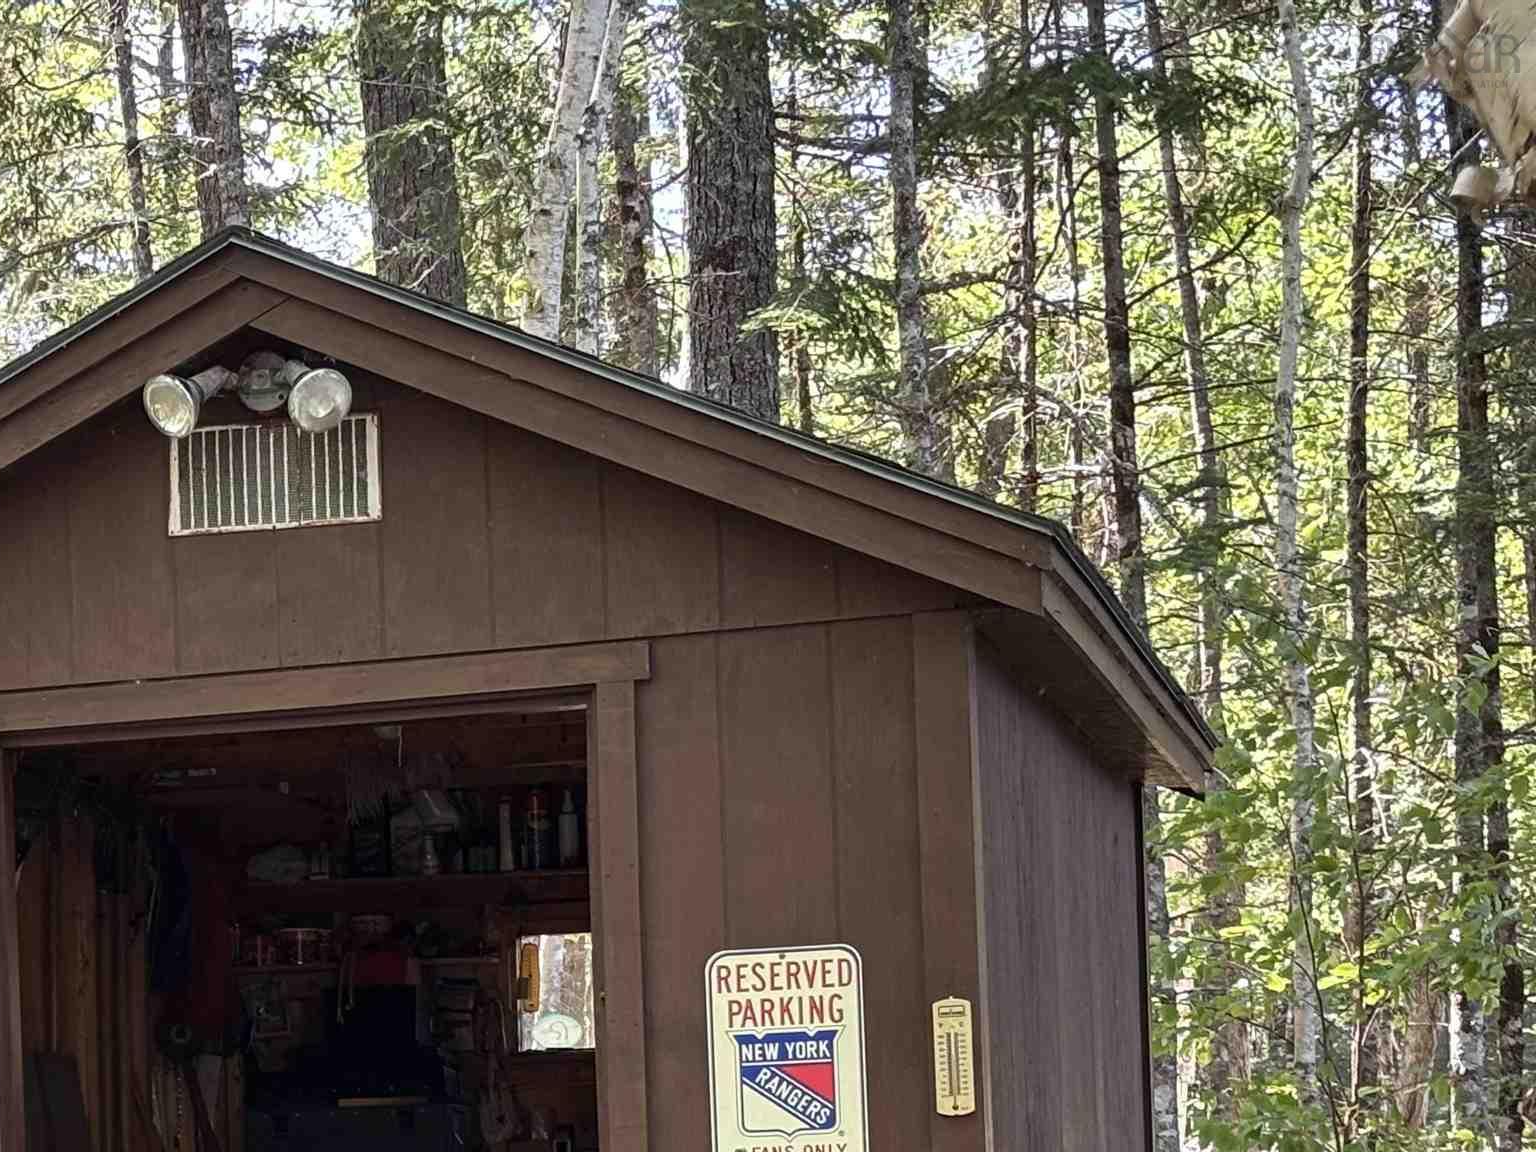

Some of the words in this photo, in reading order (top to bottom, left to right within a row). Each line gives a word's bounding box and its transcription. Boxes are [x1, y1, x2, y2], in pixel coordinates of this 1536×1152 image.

[716, 958, 853, 993] RESERVED
[727, 993, 845, 1028] PARKING
[741, 1042, 780, 1062] NEW
[785, 1039, 831, 1059] YORK
[755, 1067, 831, 1125] RANGERS
